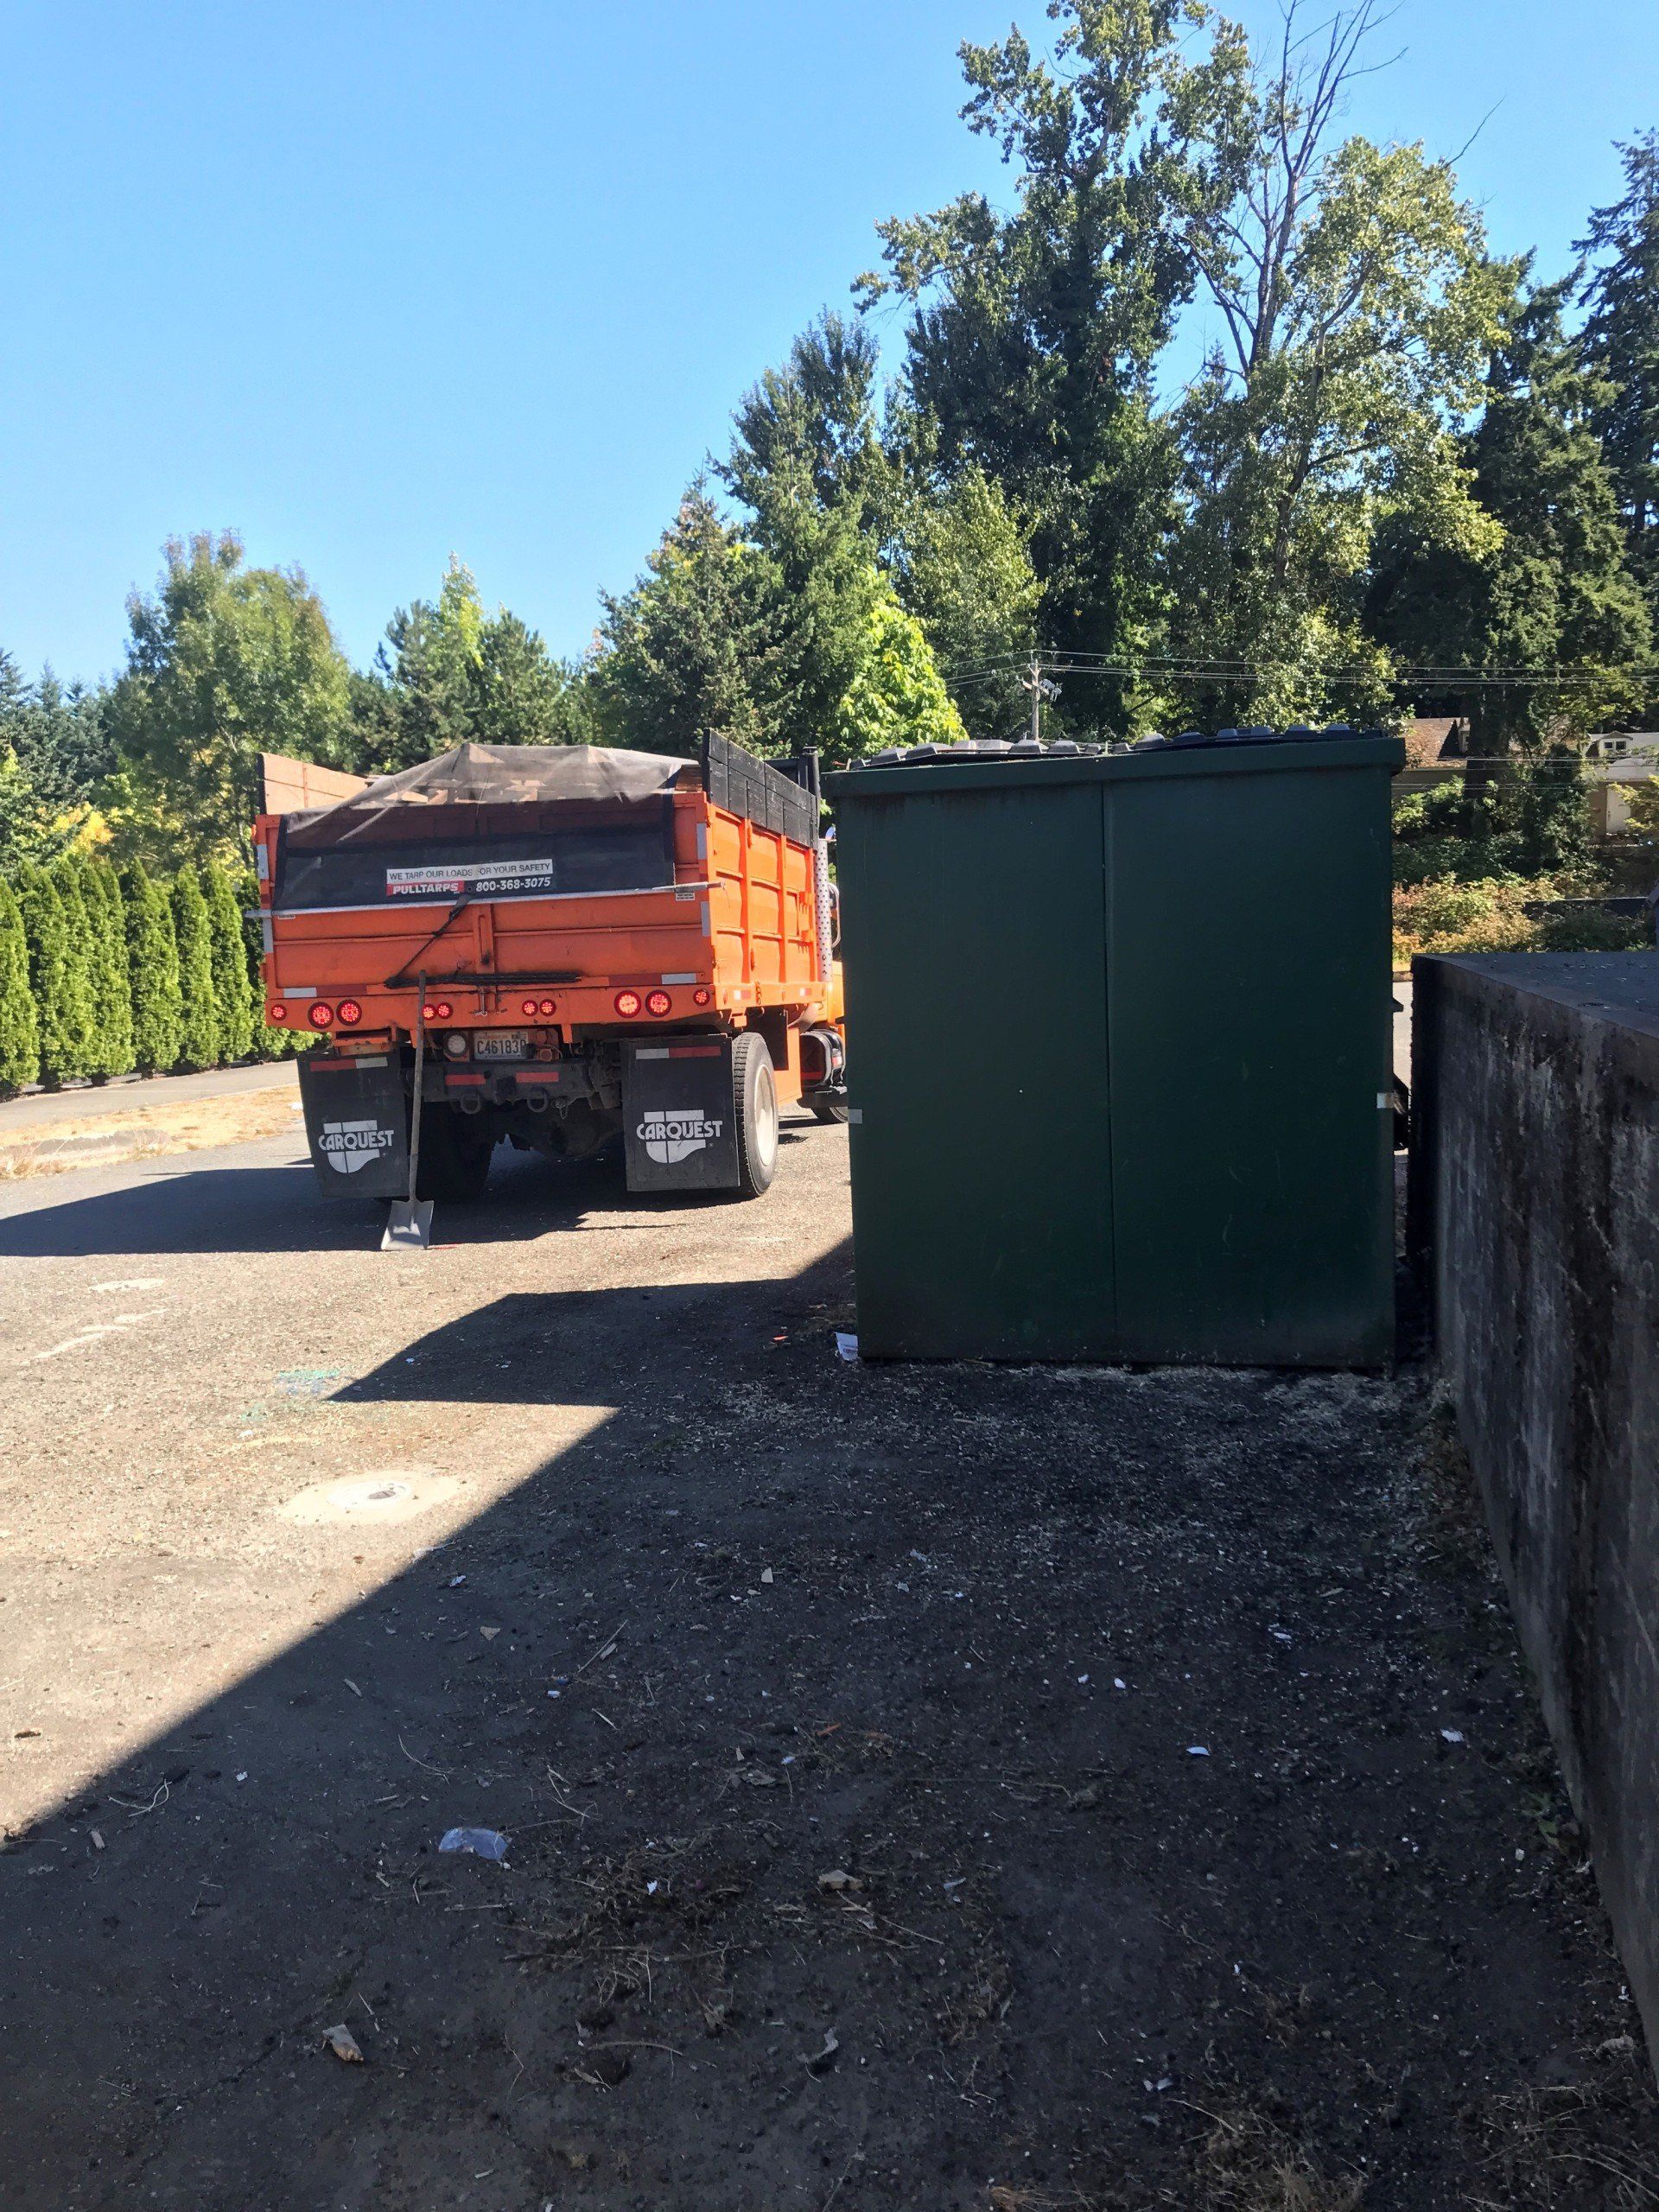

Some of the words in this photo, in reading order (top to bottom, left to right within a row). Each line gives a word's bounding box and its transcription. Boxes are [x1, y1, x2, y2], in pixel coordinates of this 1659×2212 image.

[405, 871, 424, 880] TARP
[446, 868, 473, 877] LOADS
[477, 867, 492, 875] OR
[493, 865, 517, 874] YOUR
[519, 863, 550, 872] SAFETY
[392, 882, 459, 894] PULLTARPS
[475, 877, 551, 892] 800-368-3075
[636, 1121, 723, 1140] CARQUEST
[318, 1129, 394, 1151] CARQUEST
